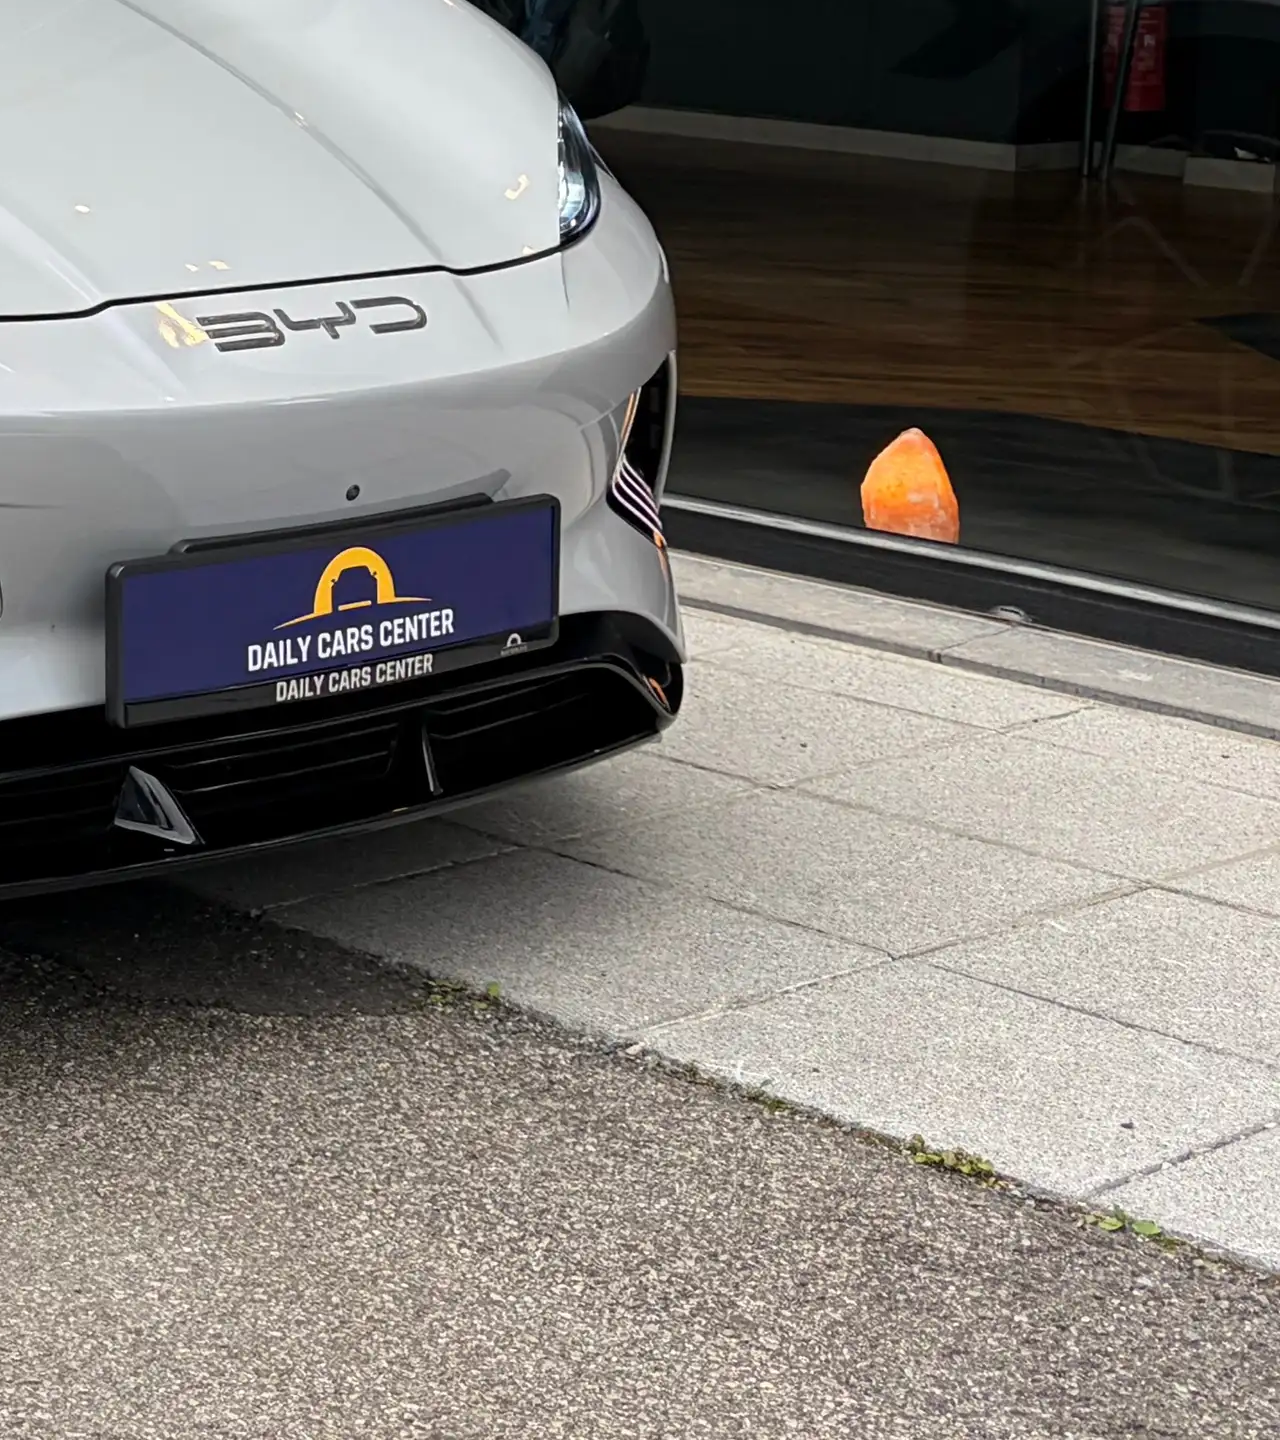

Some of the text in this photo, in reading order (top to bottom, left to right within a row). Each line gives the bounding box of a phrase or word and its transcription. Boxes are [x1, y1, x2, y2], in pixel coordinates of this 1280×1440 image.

[197, 295, 428, 353] BYD
[247, 608, 454, 673] DAILY CARS CENTER
[275, 653, 434, 703] DAILY CARS CENTER
